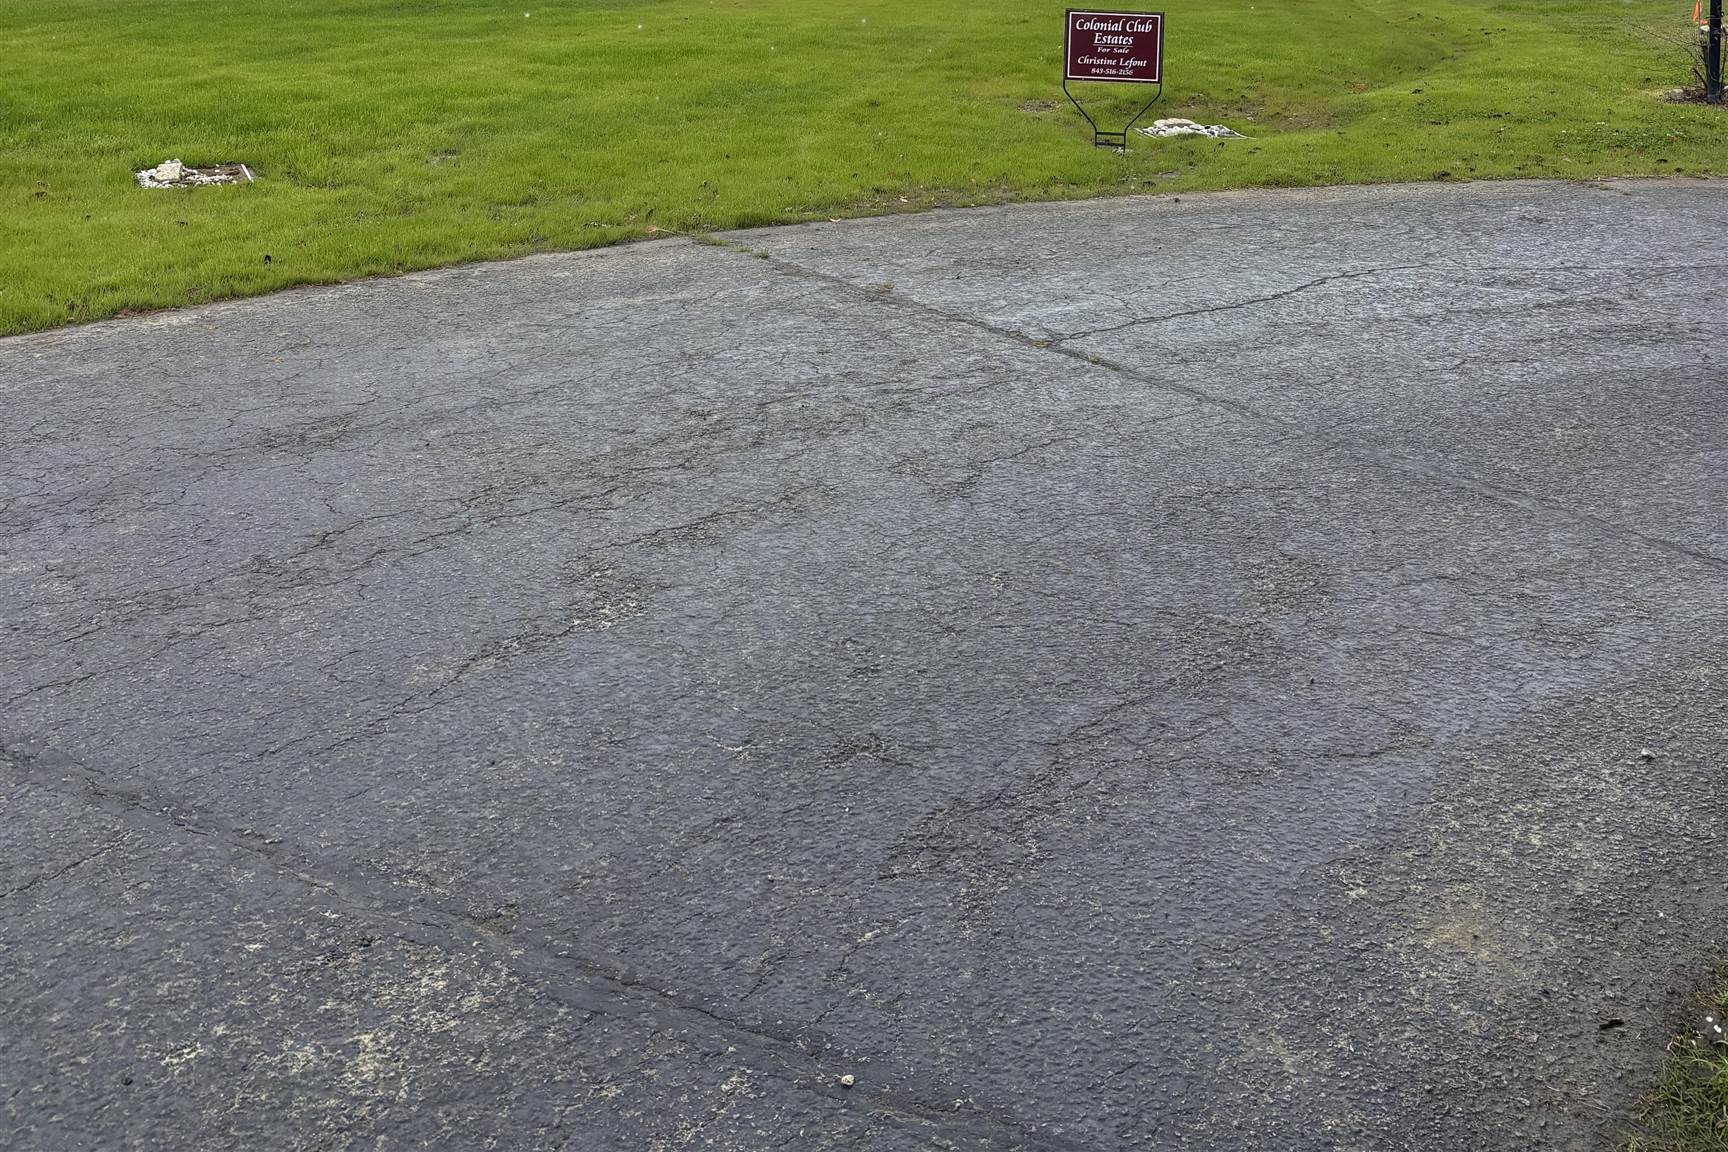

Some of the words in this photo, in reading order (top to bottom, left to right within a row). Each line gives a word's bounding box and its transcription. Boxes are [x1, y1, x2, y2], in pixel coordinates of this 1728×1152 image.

[1076, 18, 1124, 32] Colonial
[1126, 19, 1152, 33] Club
[1094, 33, 1134, 45] Estates
[1112, 46, 1130, 54] Sale
[1077, 55, 1117, 66] Christine
